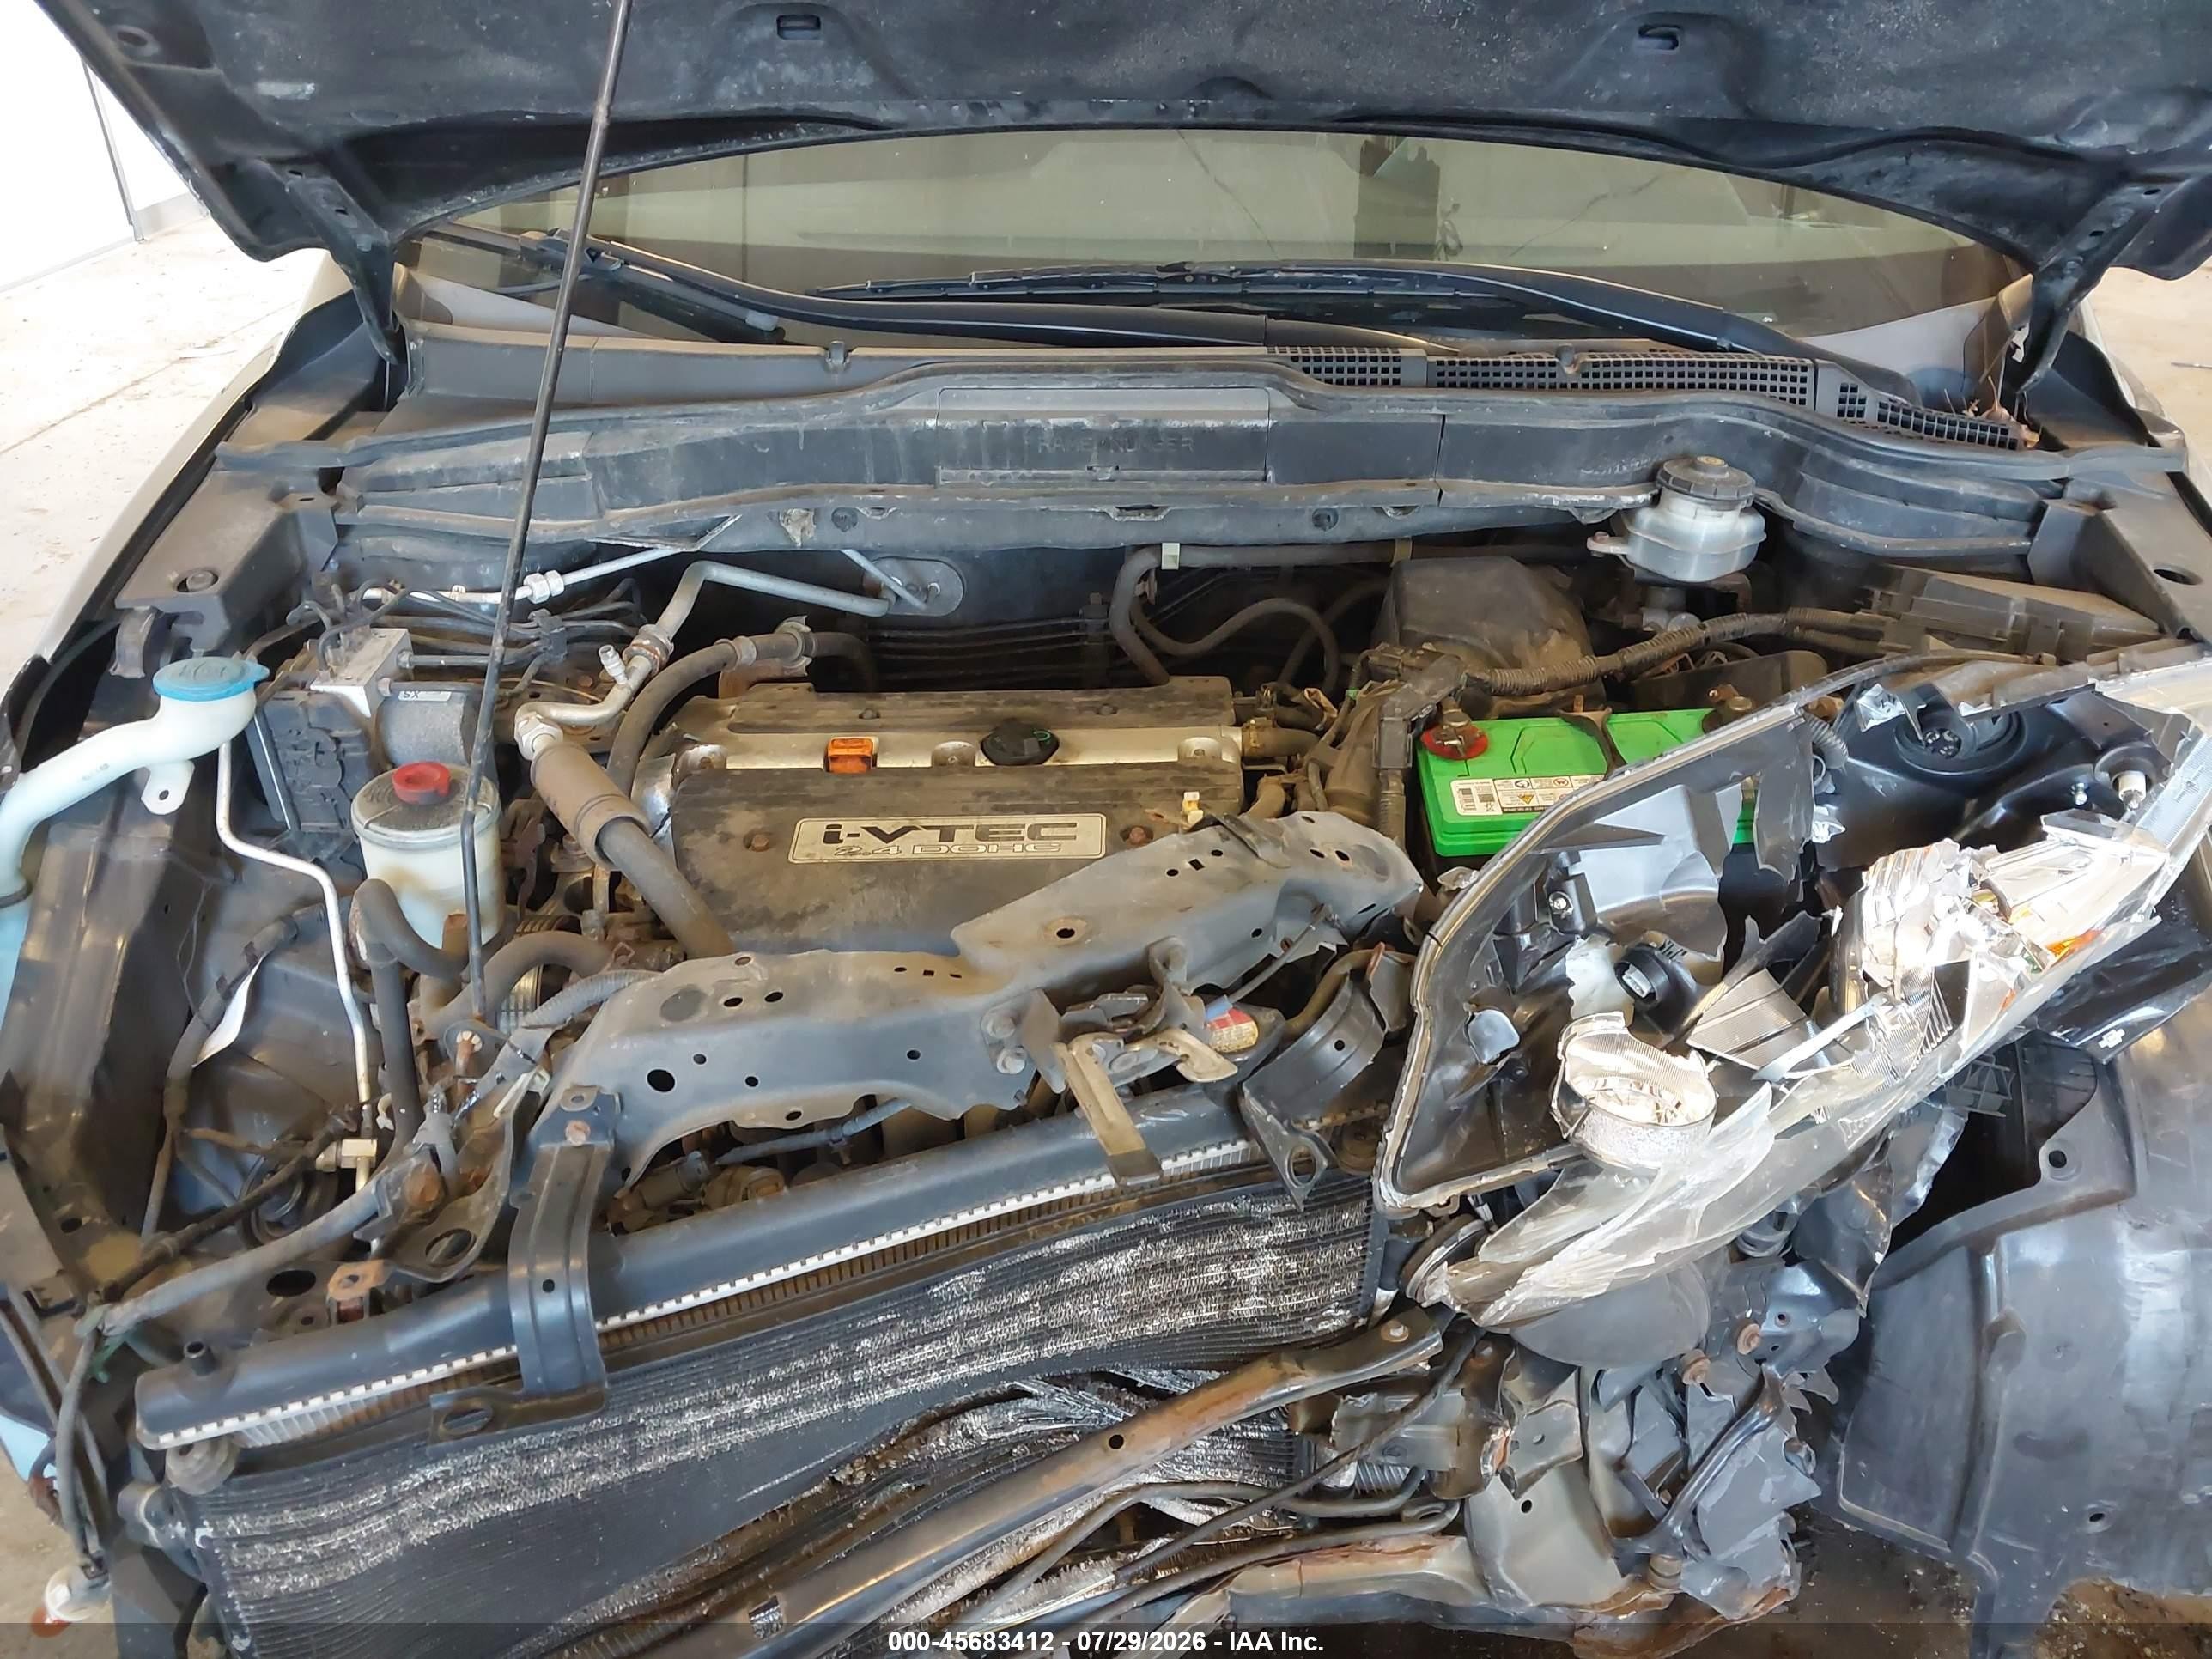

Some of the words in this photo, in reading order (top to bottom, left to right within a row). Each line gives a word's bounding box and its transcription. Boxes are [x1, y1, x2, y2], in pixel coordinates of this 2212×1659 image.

[1110, 436, 1194, 453] NUBER
[822, 822, 1078, 844] i-VTEC
[833, 844, 902, 857] 2.4
[911, 842, 1061, 855] DOHC
